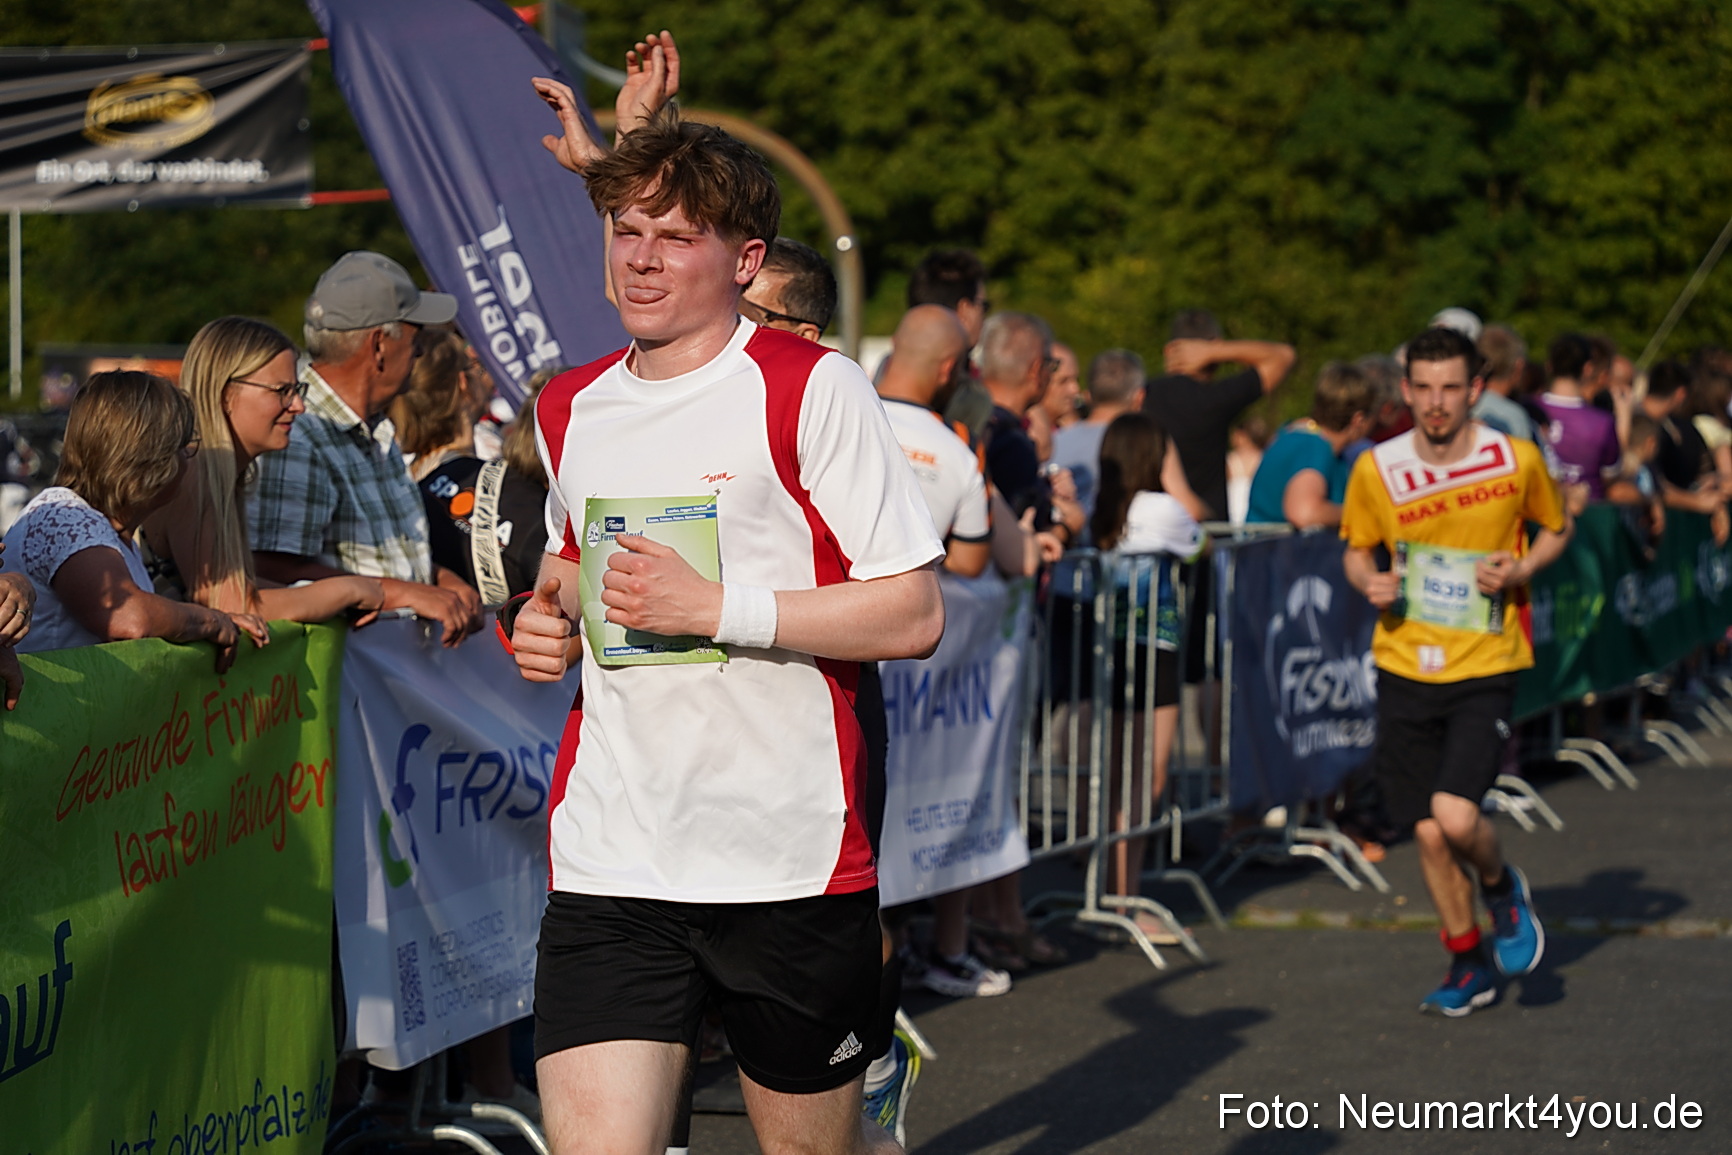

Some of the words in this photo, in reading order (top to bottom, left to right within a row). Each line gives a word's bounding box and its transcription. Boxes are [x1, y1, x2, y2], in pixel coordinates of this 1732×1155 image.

[56, 691, 194, 822] Gesunde
[203, 674, 304, 757] Firmen
[115, 792, 218, 898] laufen
[828, 1042, 863, 1066] adidas
